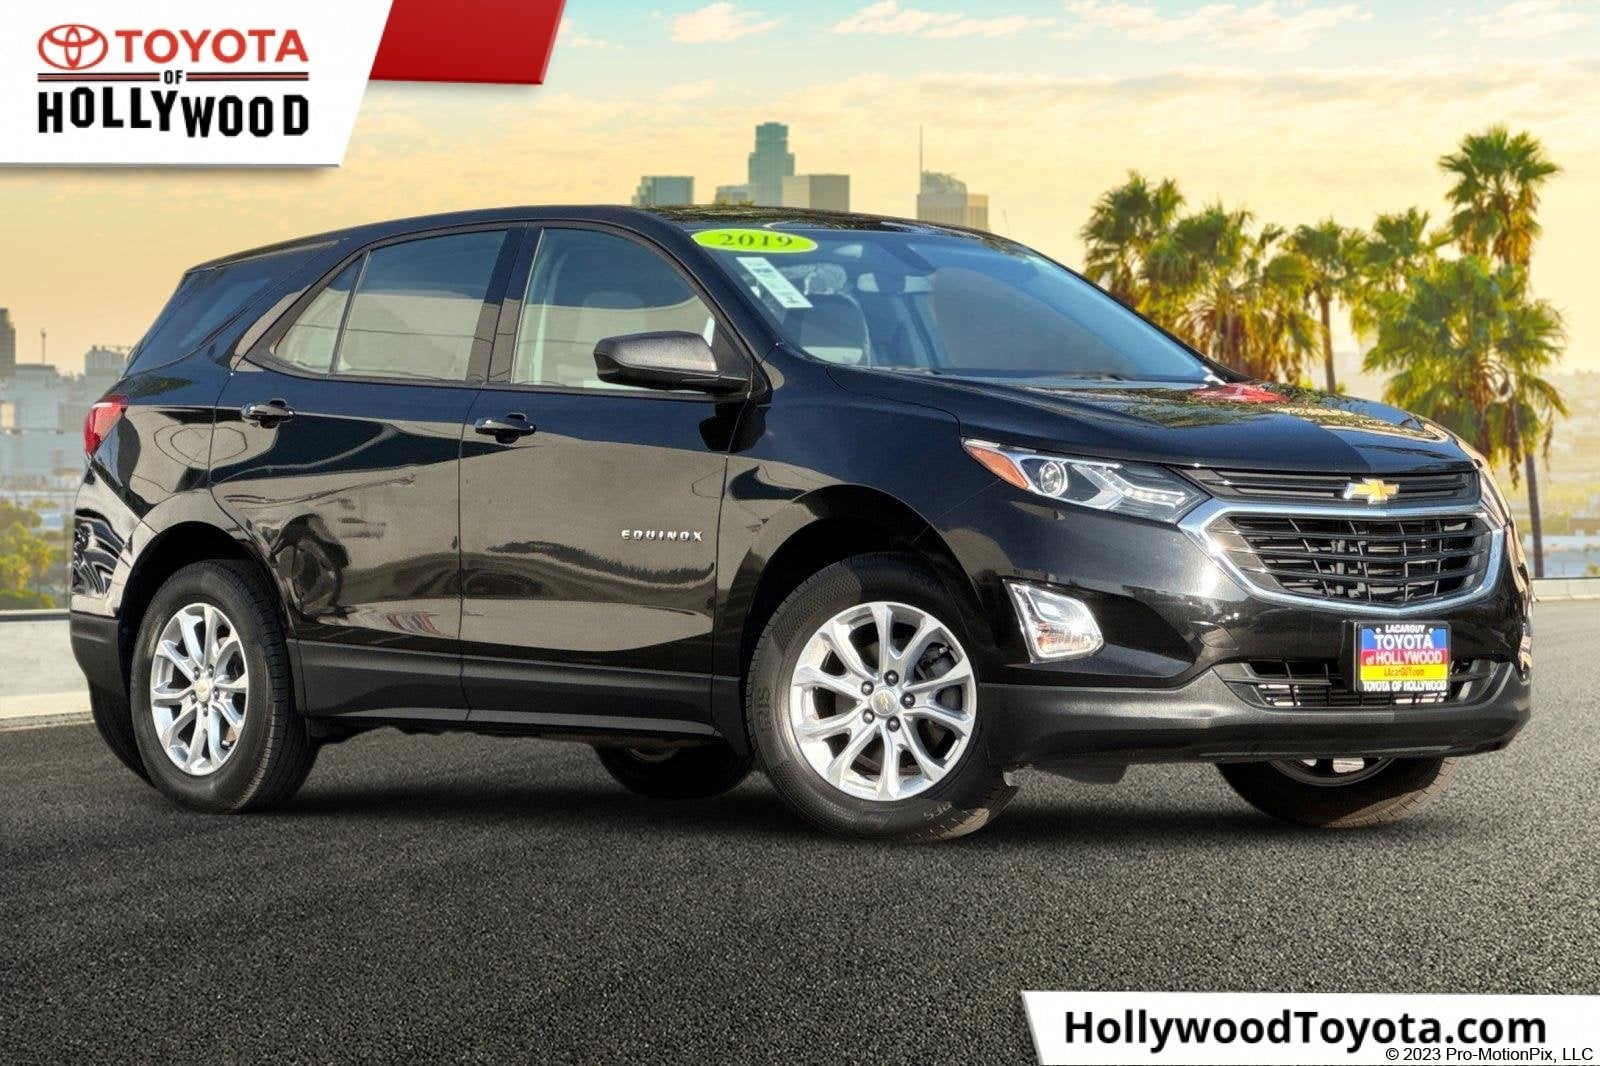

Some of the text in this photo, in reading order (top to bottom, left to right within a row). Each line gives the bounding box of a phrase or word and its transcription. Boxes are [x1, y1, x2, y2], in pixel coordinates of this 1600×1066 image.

[718, 233, 793, 247] 2019
[621, 529, 702, 541] EQUINOX
[1385, 625, 1425, 633] LACARGUY
[1374, 634, 1434, 650] TOYOTA
[1376, 650, 1443, 665] HOLLYWOOD
[1363, 681, 1447, 692] TOYOTA OF HOLLYWOOD
